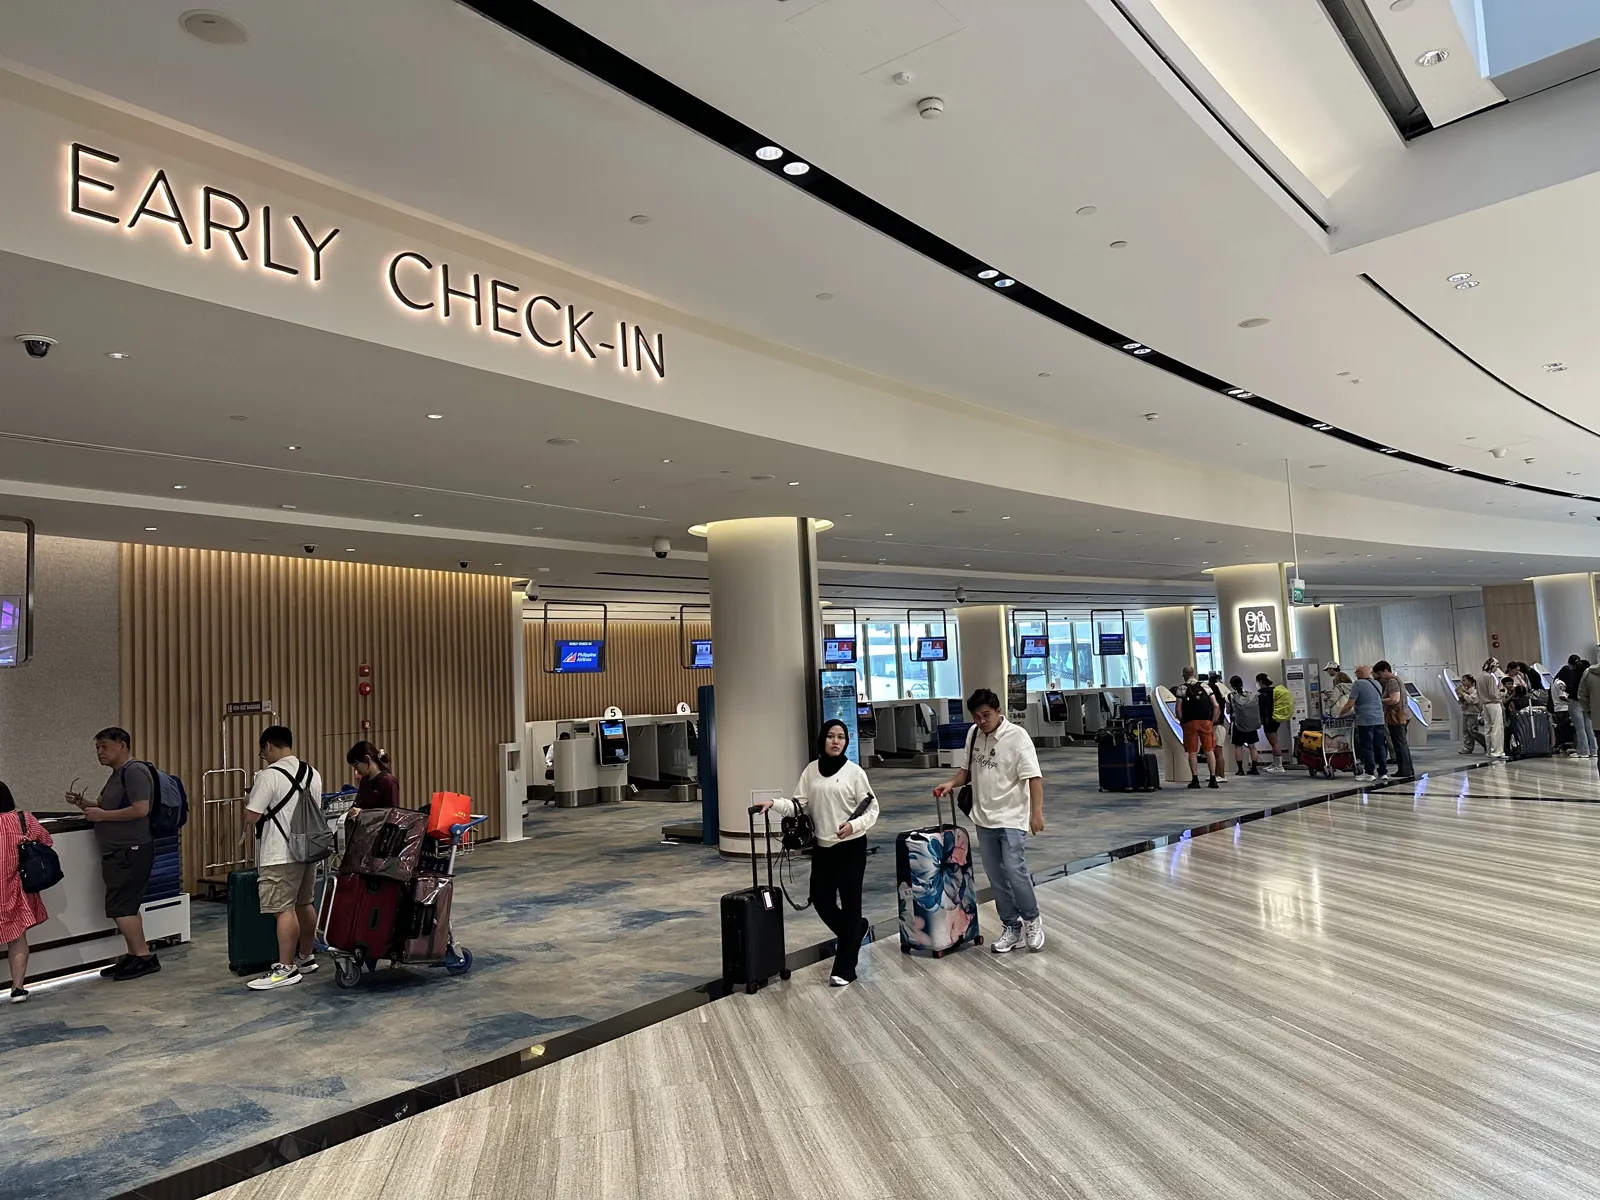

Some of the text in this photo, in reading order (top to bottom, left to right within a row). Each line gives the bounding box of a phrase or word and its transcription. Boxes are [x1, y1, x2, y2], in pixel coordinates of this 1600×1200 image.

[68, 142, 665, 378] EARLY CHECK-IN
[1246, 633, 1271, 643] FAST
[610, 708, 616, 717] 5
[680, 704, 686, 712] 6
